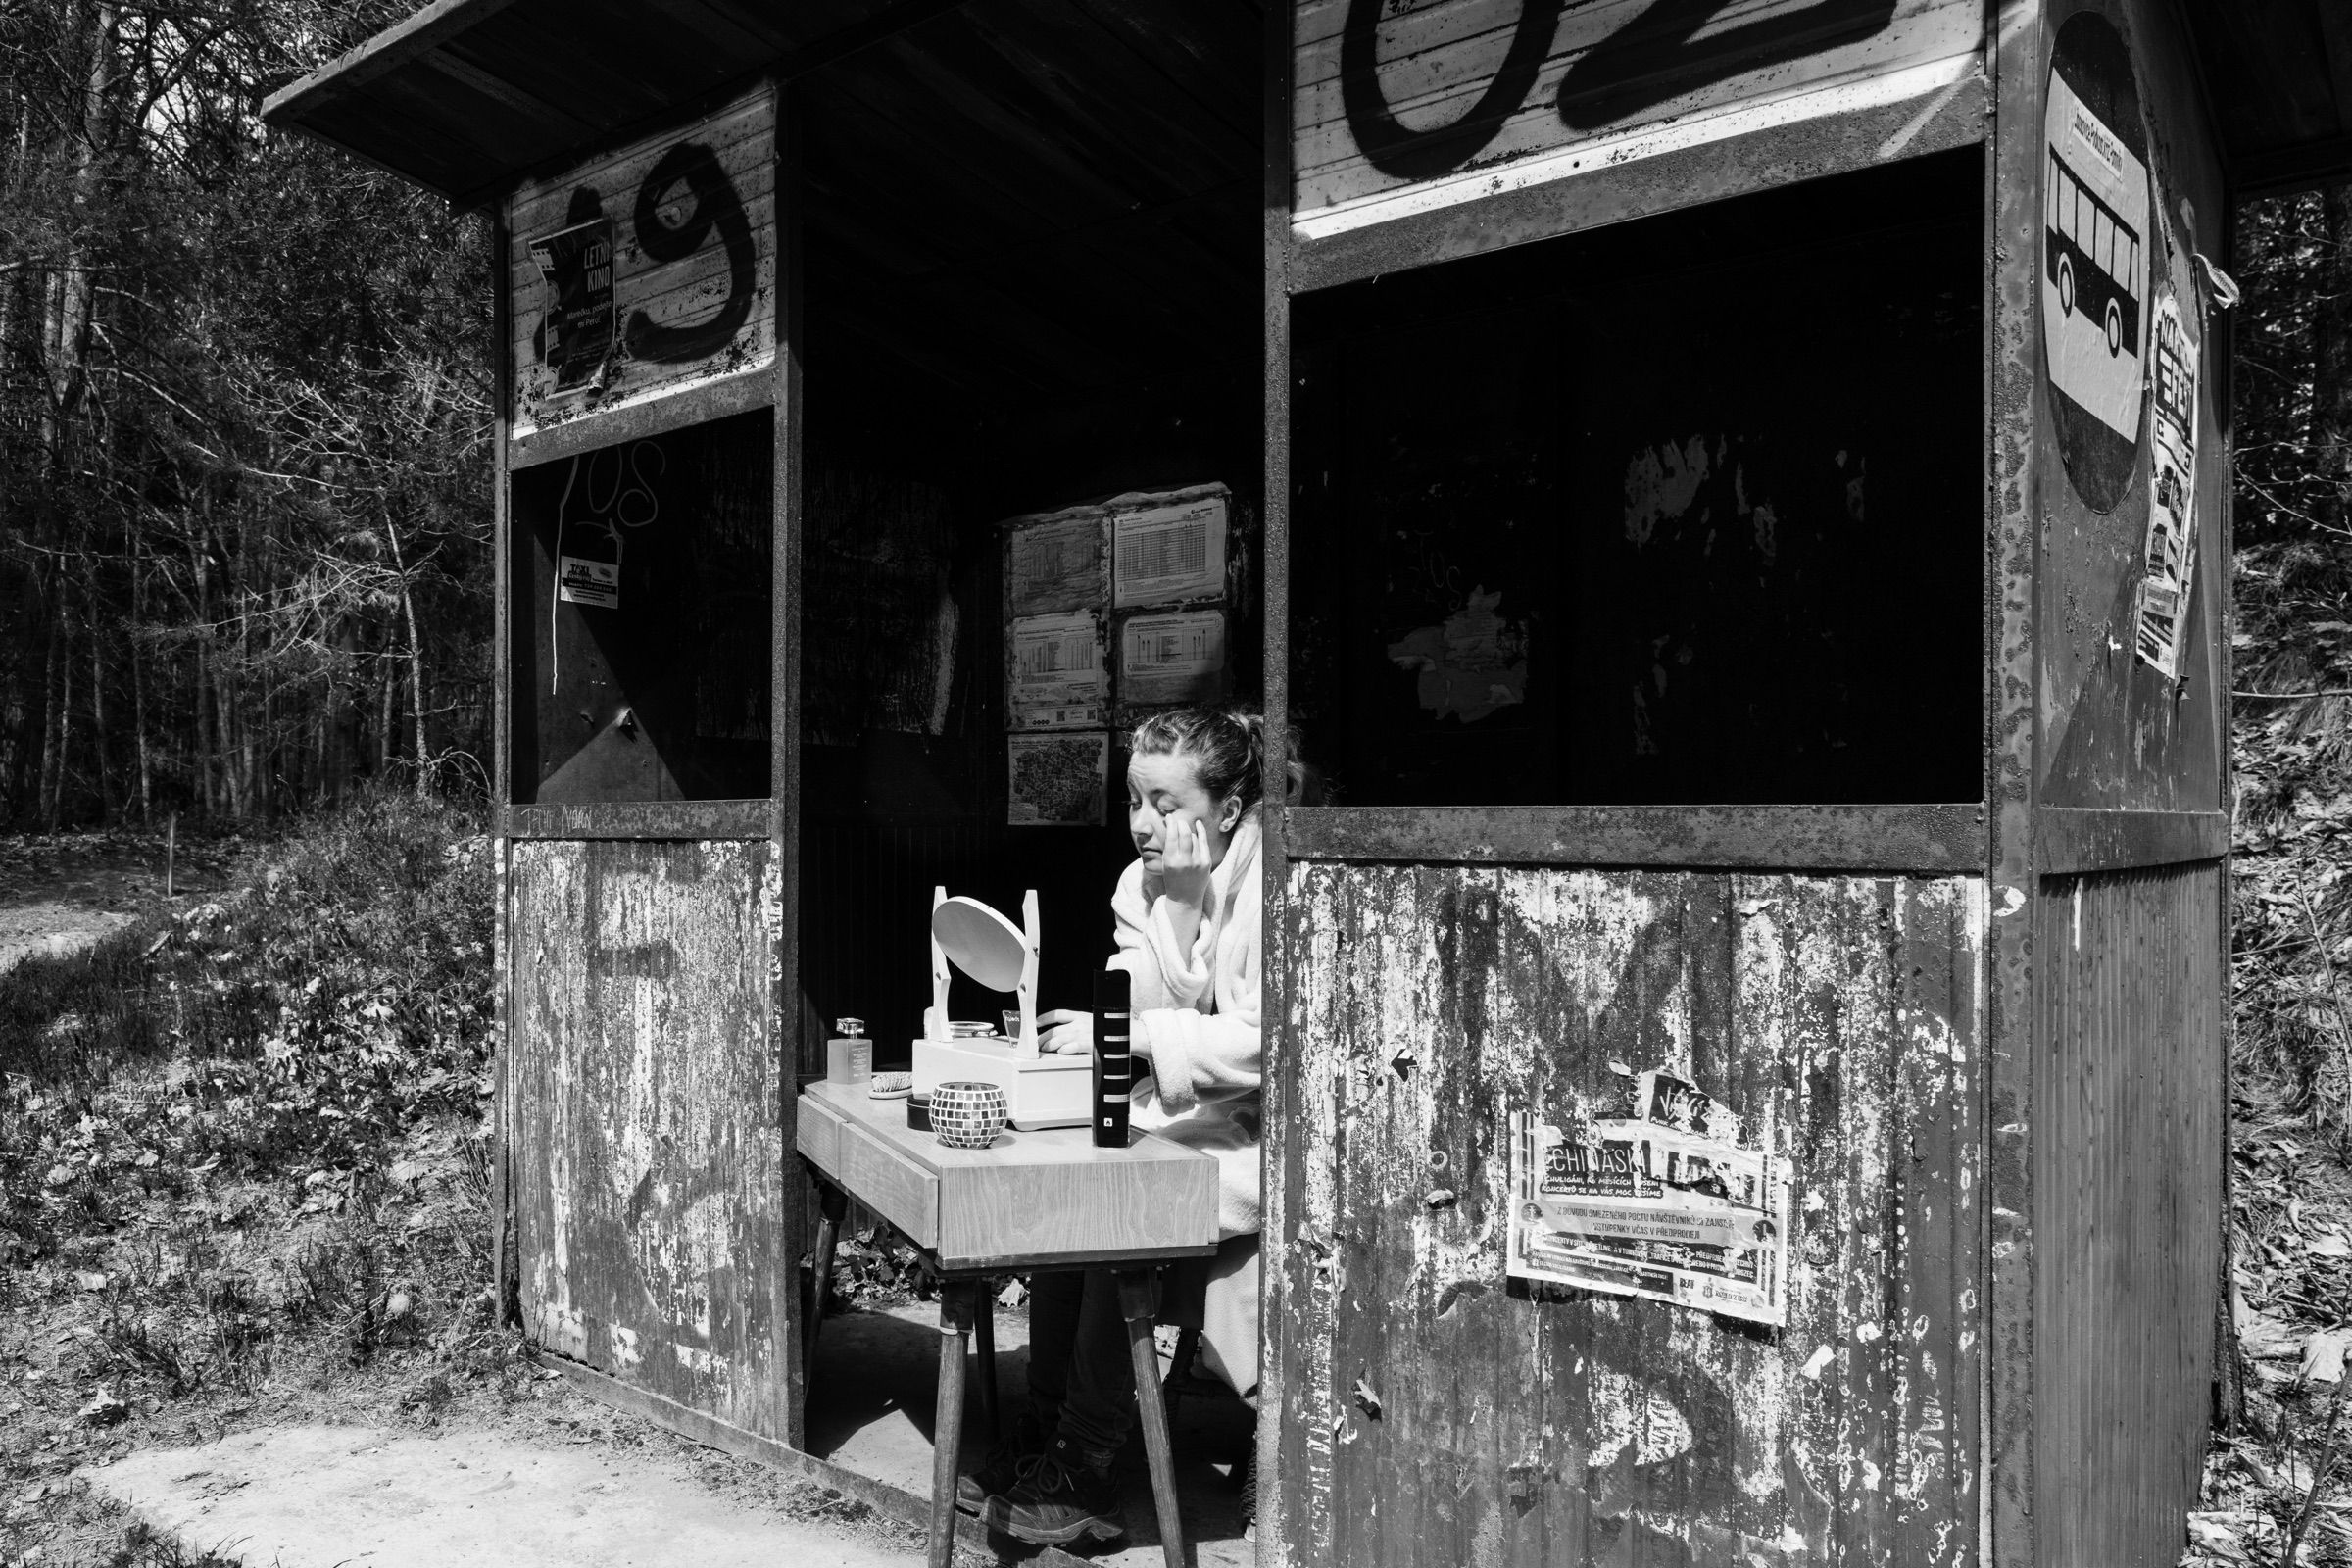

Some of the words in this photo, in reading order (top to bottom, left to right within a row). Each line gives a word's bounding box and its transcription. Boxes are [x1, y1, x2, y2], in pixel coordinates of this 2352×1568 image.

[588, 265, 610, 293] KINO
[570, 564, 590, 576] TAXI
[1552, 1148, 1646, 1174] CHINASKI
